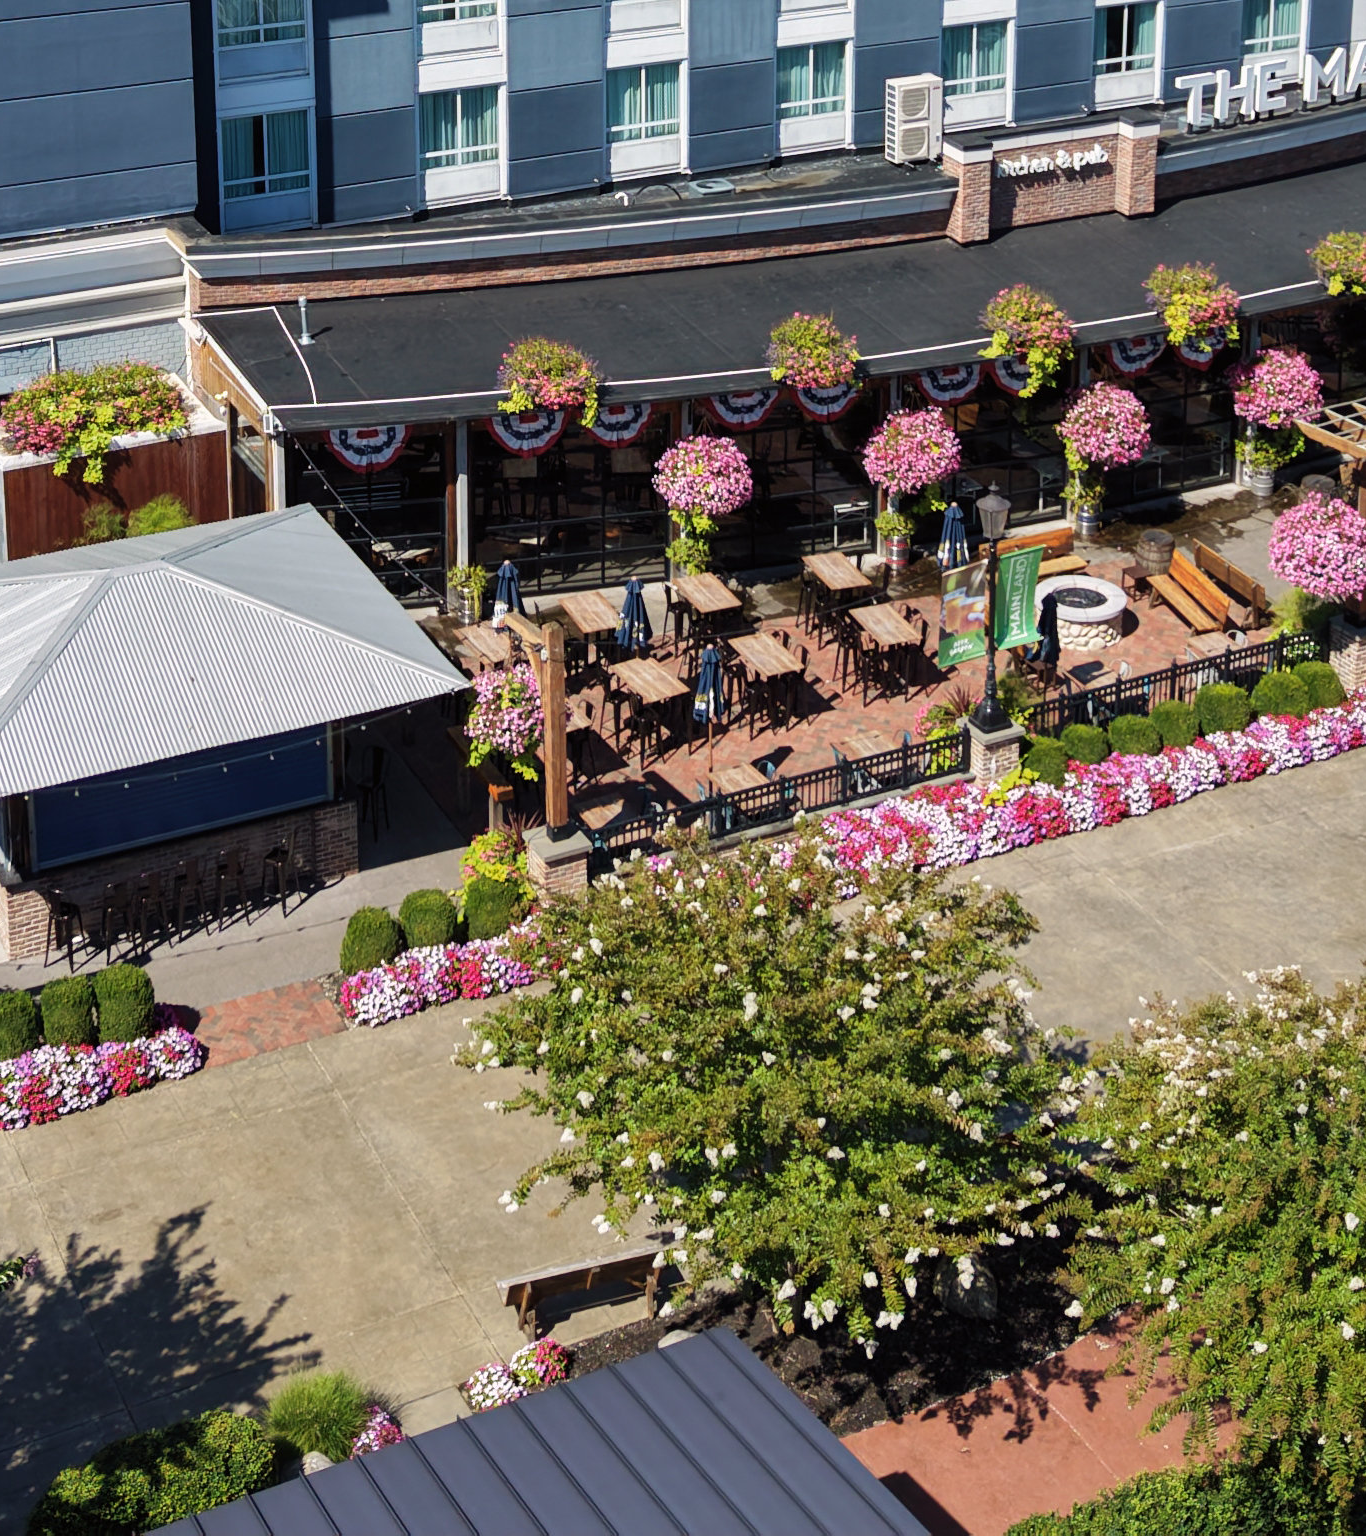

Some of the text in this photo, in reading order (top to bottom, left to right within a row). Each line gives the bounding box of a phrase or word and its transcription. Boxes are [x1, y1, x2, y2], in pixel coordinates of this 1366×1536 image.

[1175, 59, 1288, 126] THE
[1073, 143, 1109, 171] pub
[1009, 558, 1028, 636] MAINLAND
